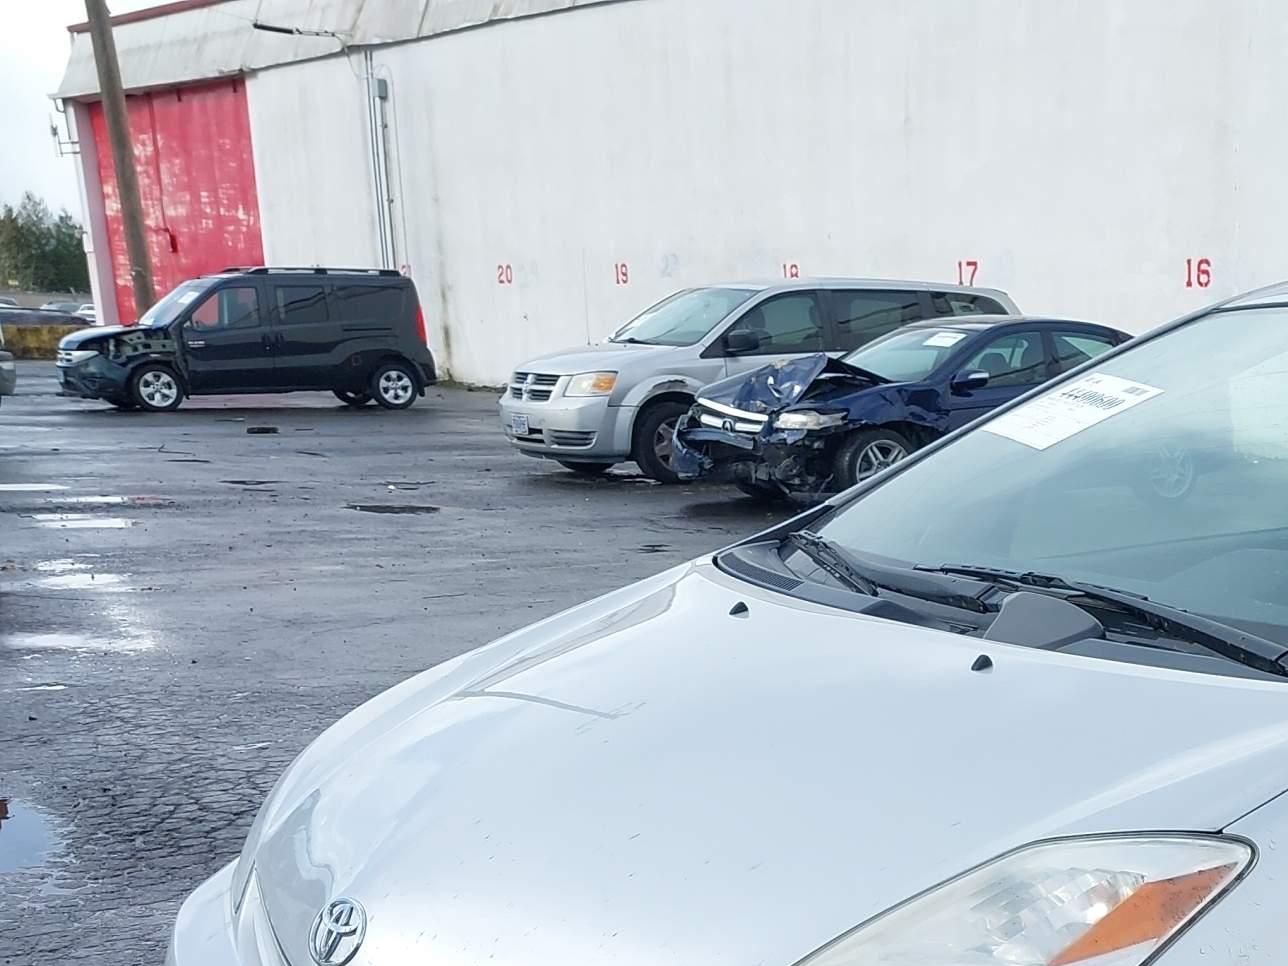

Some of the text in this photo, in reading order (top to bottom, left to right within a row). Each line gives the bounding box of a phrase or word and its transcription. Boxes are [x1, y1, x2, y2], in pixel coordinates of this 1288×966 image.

[497, 264, 513, 284] 20
[614, 263, 628, 284] 19
[958, 260, 978, 287] 17
[1186, 258, 1211, 288] 16
